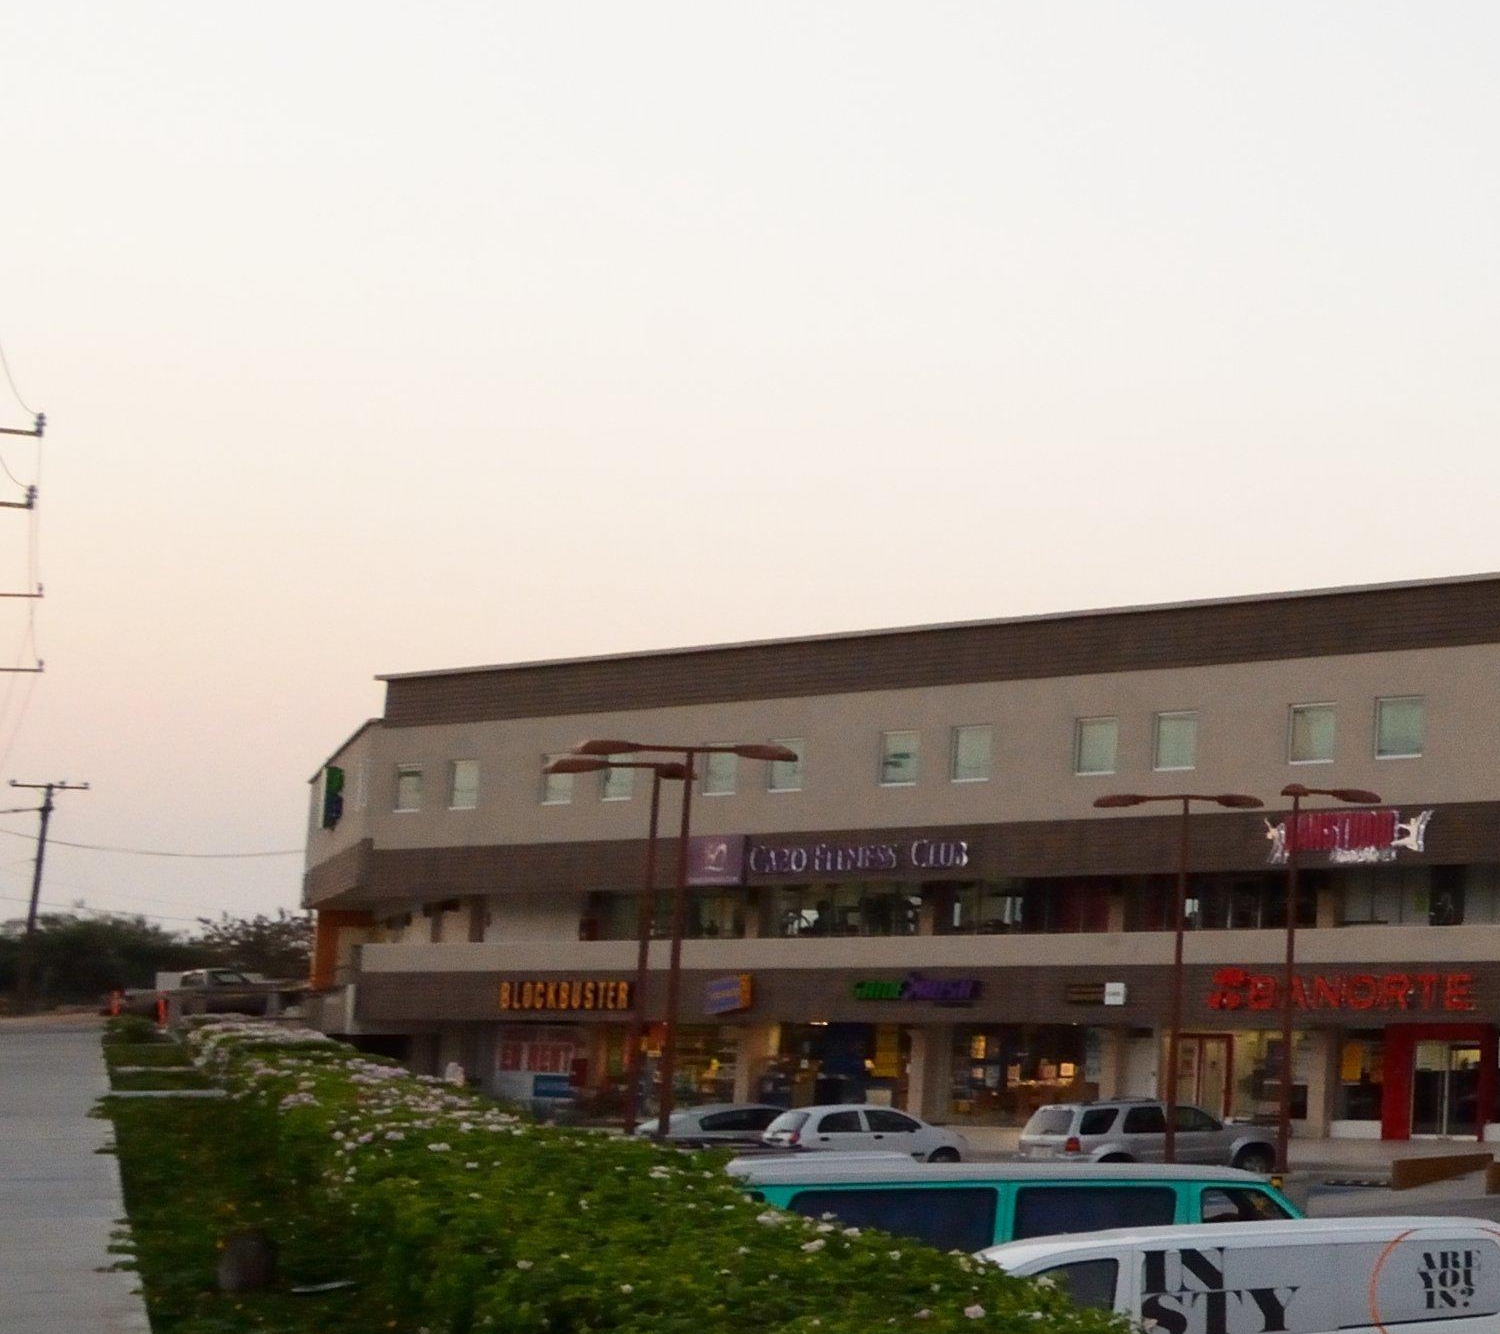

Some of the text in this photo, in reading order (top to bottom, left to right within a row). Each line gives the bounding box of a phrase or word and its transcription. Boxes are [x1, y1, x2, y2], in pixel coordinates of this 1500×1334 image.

[750, 845, 807, 873] CABO
[911, 839, 968, 867] CLUB
[500, 981, 631, 1010] BLOCKBUSTER
[1249, 973, 1474, 1011] BANORTE
[1140, 1246, 1226, 1293] IN
[1423, 1250, 1481, 1270] ARE
[1418, 1268, 1475, 1288] YOU
[1426, 1287, 1475, 1309] IN?
